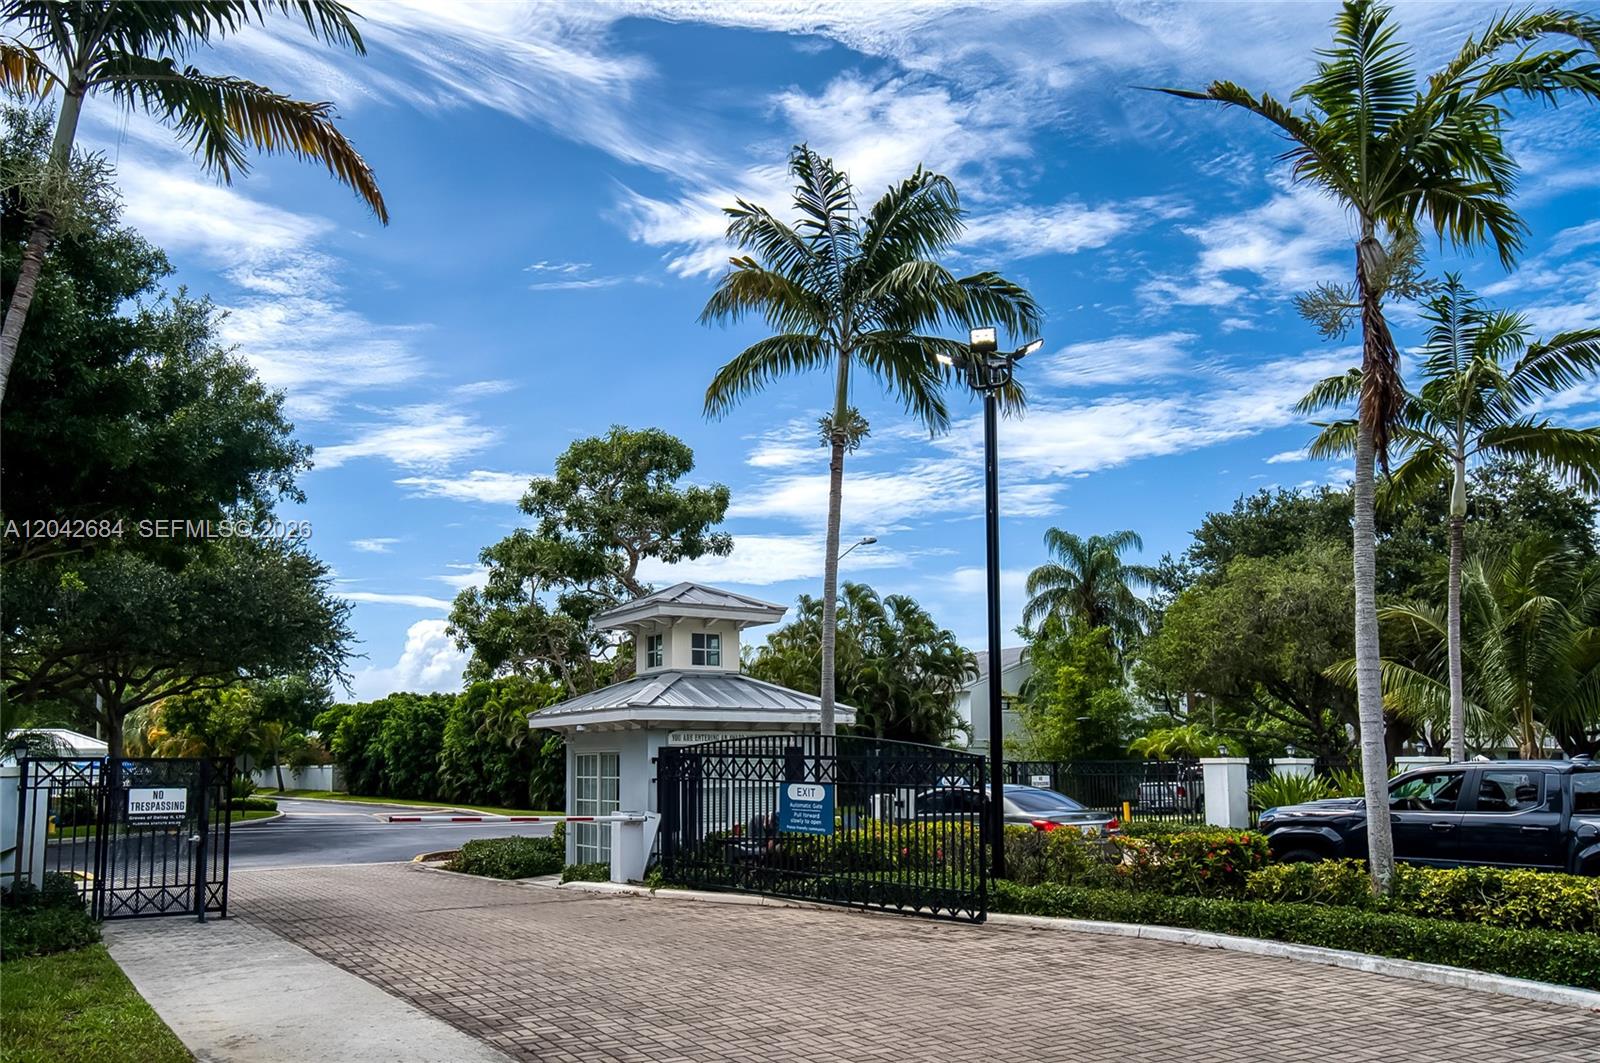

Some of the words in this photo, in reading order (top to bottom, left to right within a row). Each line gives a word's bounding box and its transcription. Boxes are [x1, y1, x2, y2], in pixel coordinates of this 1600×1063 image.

[683, 733, 693, 742] ARE
[152, 790, 164, 800] NO
[796, 787, 816, 797] EXIT
[130, 801, 185, 811] TRESPASSING
